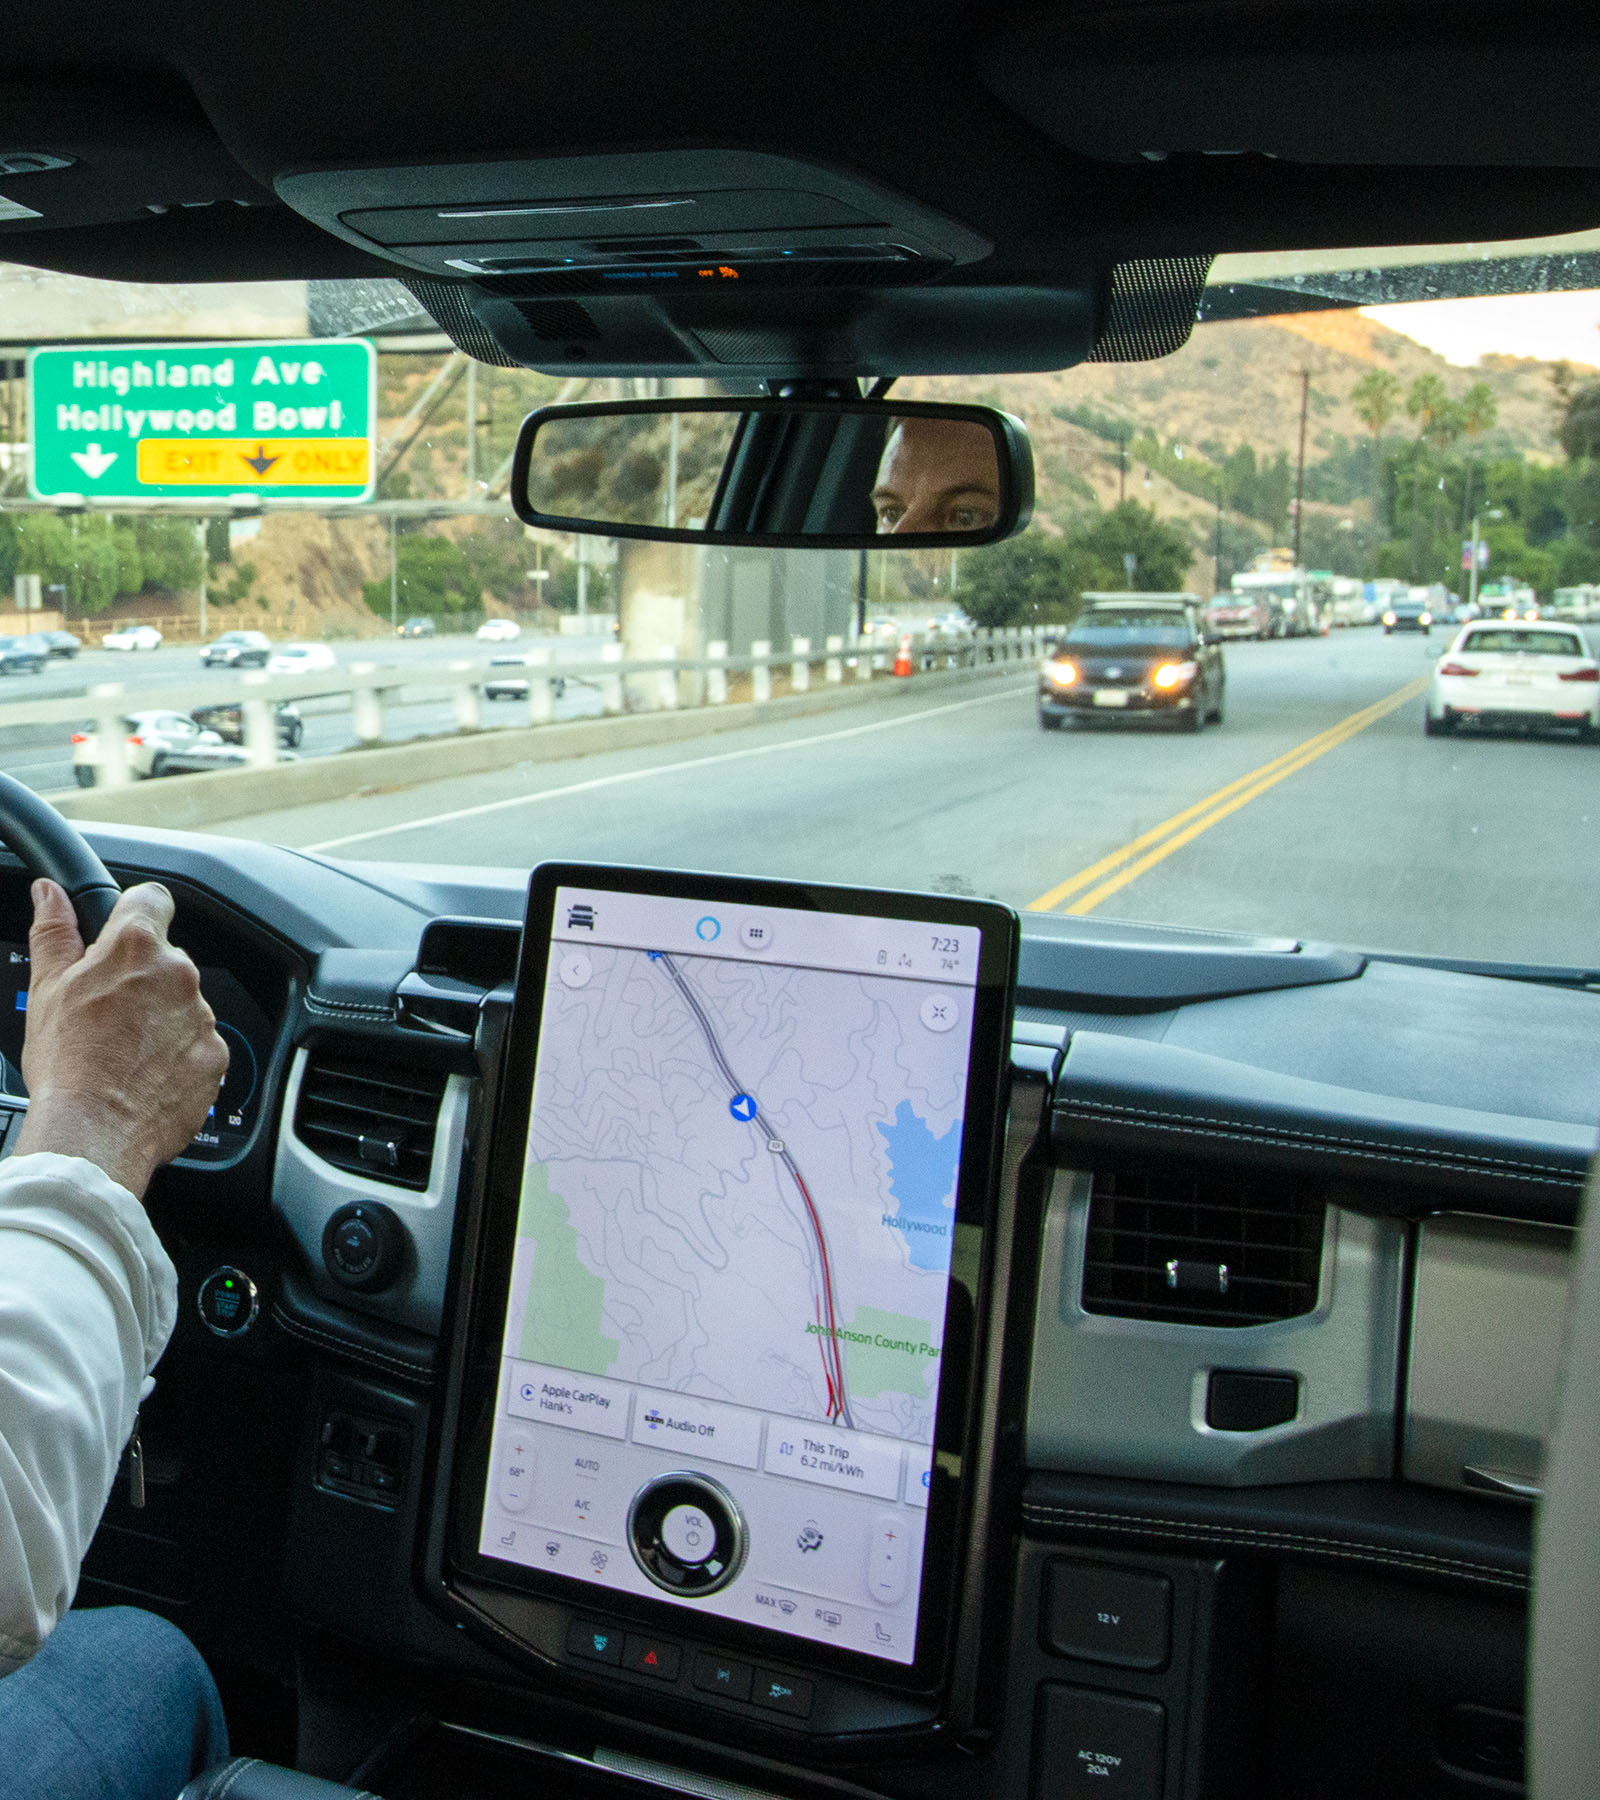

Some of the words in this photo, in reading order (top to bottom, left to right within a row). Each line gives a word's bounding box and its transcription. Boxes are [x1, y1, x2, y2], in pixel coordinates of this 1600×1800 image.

[698, 269, 714, 277] OFF
[72, 358, 234, 396] Highland
[251, 356, 324, 386] Ave
[56, 402, 237, 438] Hollywood
[252, 399, 343, 431] Bowl
[165, 450, 224, 473] EXIT
[292, 449, 367, 475] ONLY
[931, 936, 960, 953] 7:23
[881, 1213, 948, 1237] Hollywood
[805, 1321, 833, 1337] John
[835, 1327, 872, 1345] Anson
[874, 1334, 918, 1355] County
[541, 1383, 572, 1401] Apple
[572, 1390, 612, 1410] CarPlay
[540, 1399, 573, 1415] Hank's
[665, 1417, 697, 1434] Audio
[698, 1423, 716, 1437] Off
[803, 1438, 826, 1455] This
[828, 1444, 850, 1460] Trip
[574, 1457, 600, 1472] AUTO
[800, 1455, 818, 1470] 6.2
[819, 1458, 865, 1480] mi/kWh
[574, 1499, 592, 1512] A/C
[684, 1514, 704, 1529] VOL
[755, 1593, 778, 1609] MAX
[1097, 1612, 1110, 1625] 12
[1111, 1615, 1122, 1625] V
[1077, 1749, 1094, 1762] AC
[1095, 1752, 1123, 1767] 120V
[1086, 1763, 1111, 1777] 20A
